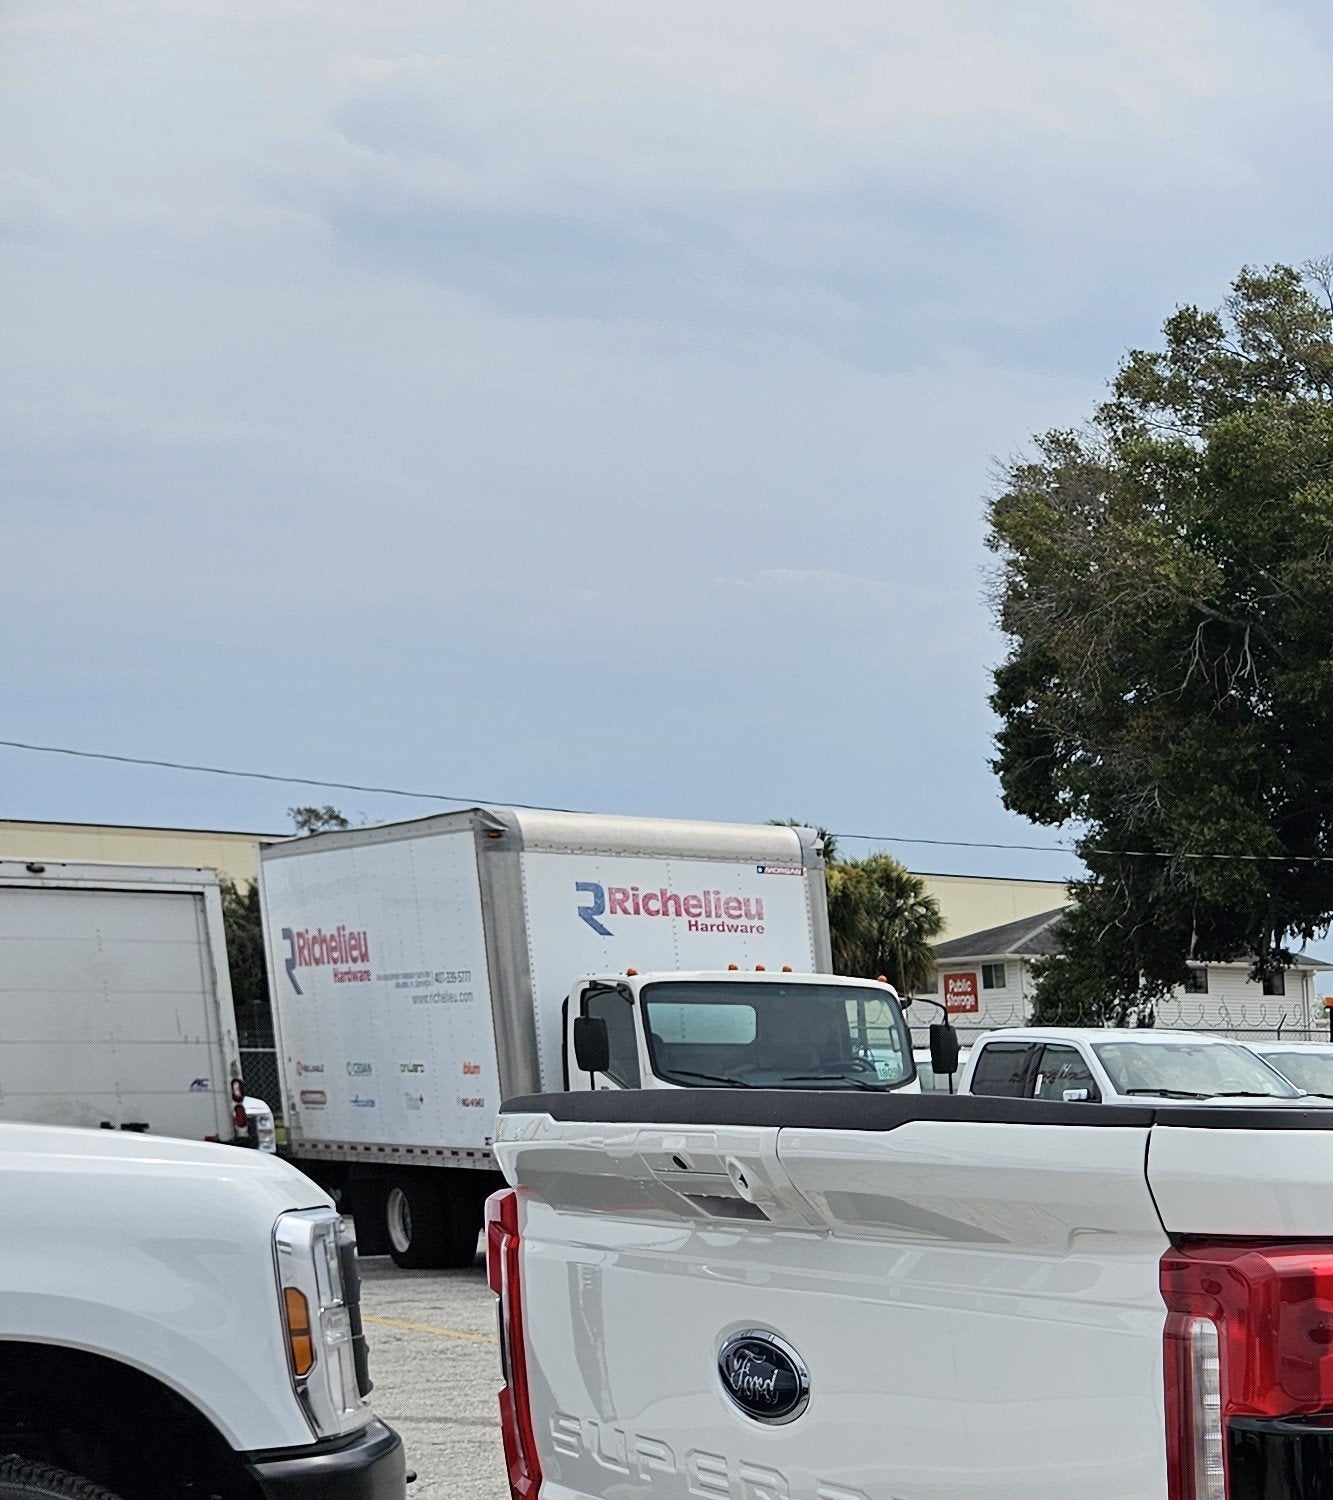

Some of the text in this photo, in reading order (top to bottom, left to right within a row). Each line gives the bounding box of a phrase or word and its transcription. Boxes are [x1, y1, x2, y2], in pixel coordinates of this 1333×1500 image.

[607, 886, 764, 921] Richelieu
[687, 919, 765, 934] Hardware
[295, 925, 370, 968] Richelieu
[332, 967, 371, 983] Hardware
[949, 979, 972, 992] Public
[947, 993, 976, 1009] Storage
[730, 1347, 780, 1396] Ford
